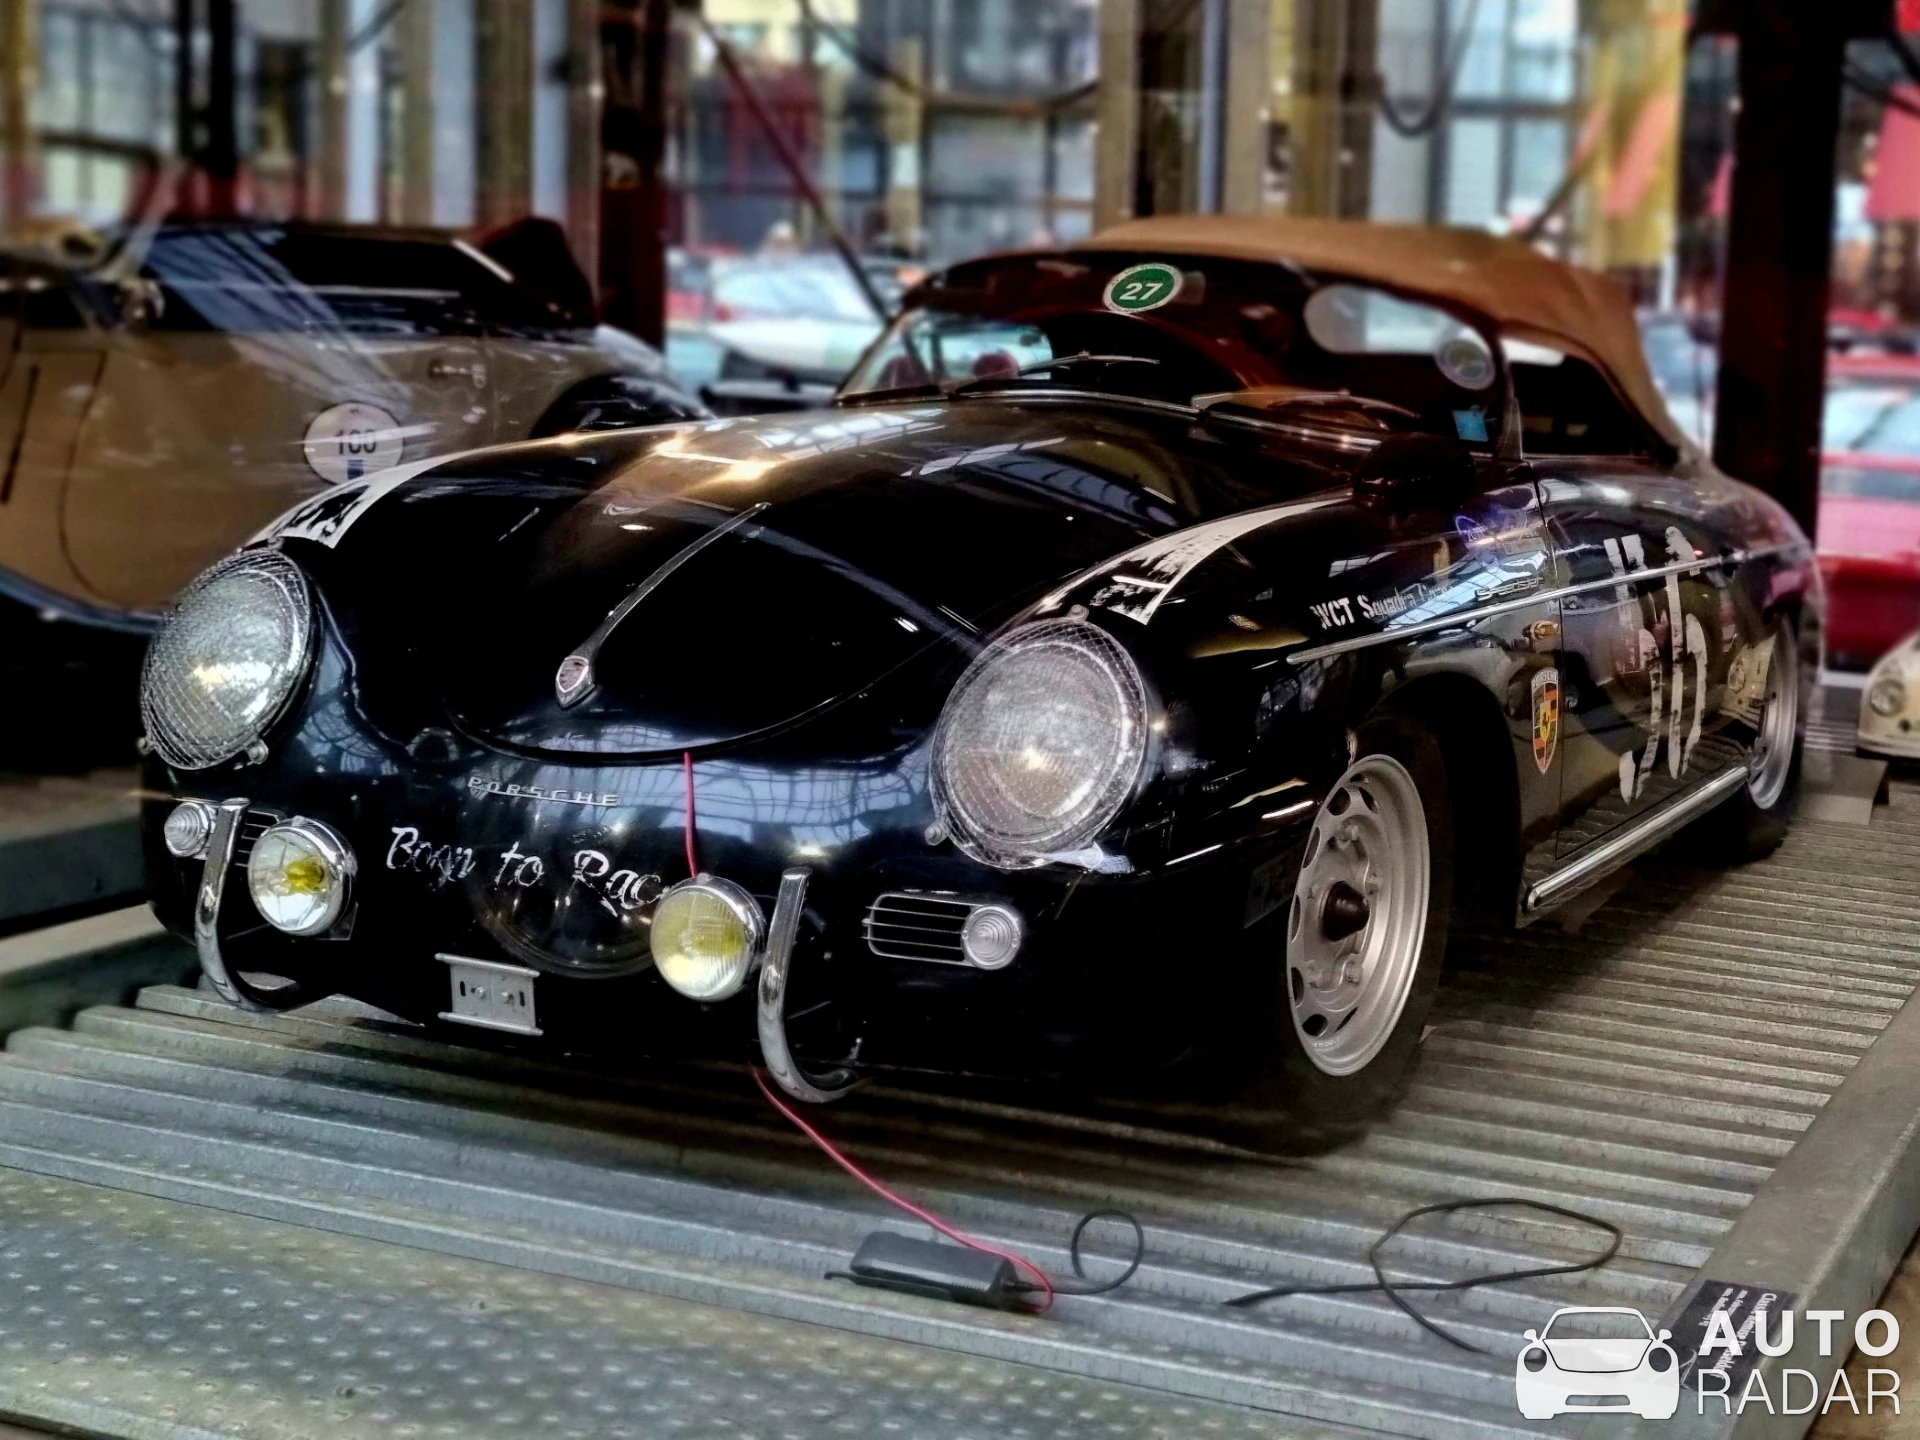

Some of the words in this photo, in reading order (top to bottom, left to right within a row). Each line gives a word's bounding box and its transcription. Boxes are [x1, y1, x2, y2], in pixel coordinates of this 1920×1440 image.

[1118, 282, 1164, 301] 27
[335, 429, 378, 455] 100
[1309, 597, 1356, 630] WCT
[467, 776, 620, 806] PORSCHE
[494, 841, 545, 890] to
[572, 850, 667, 918] Rac
